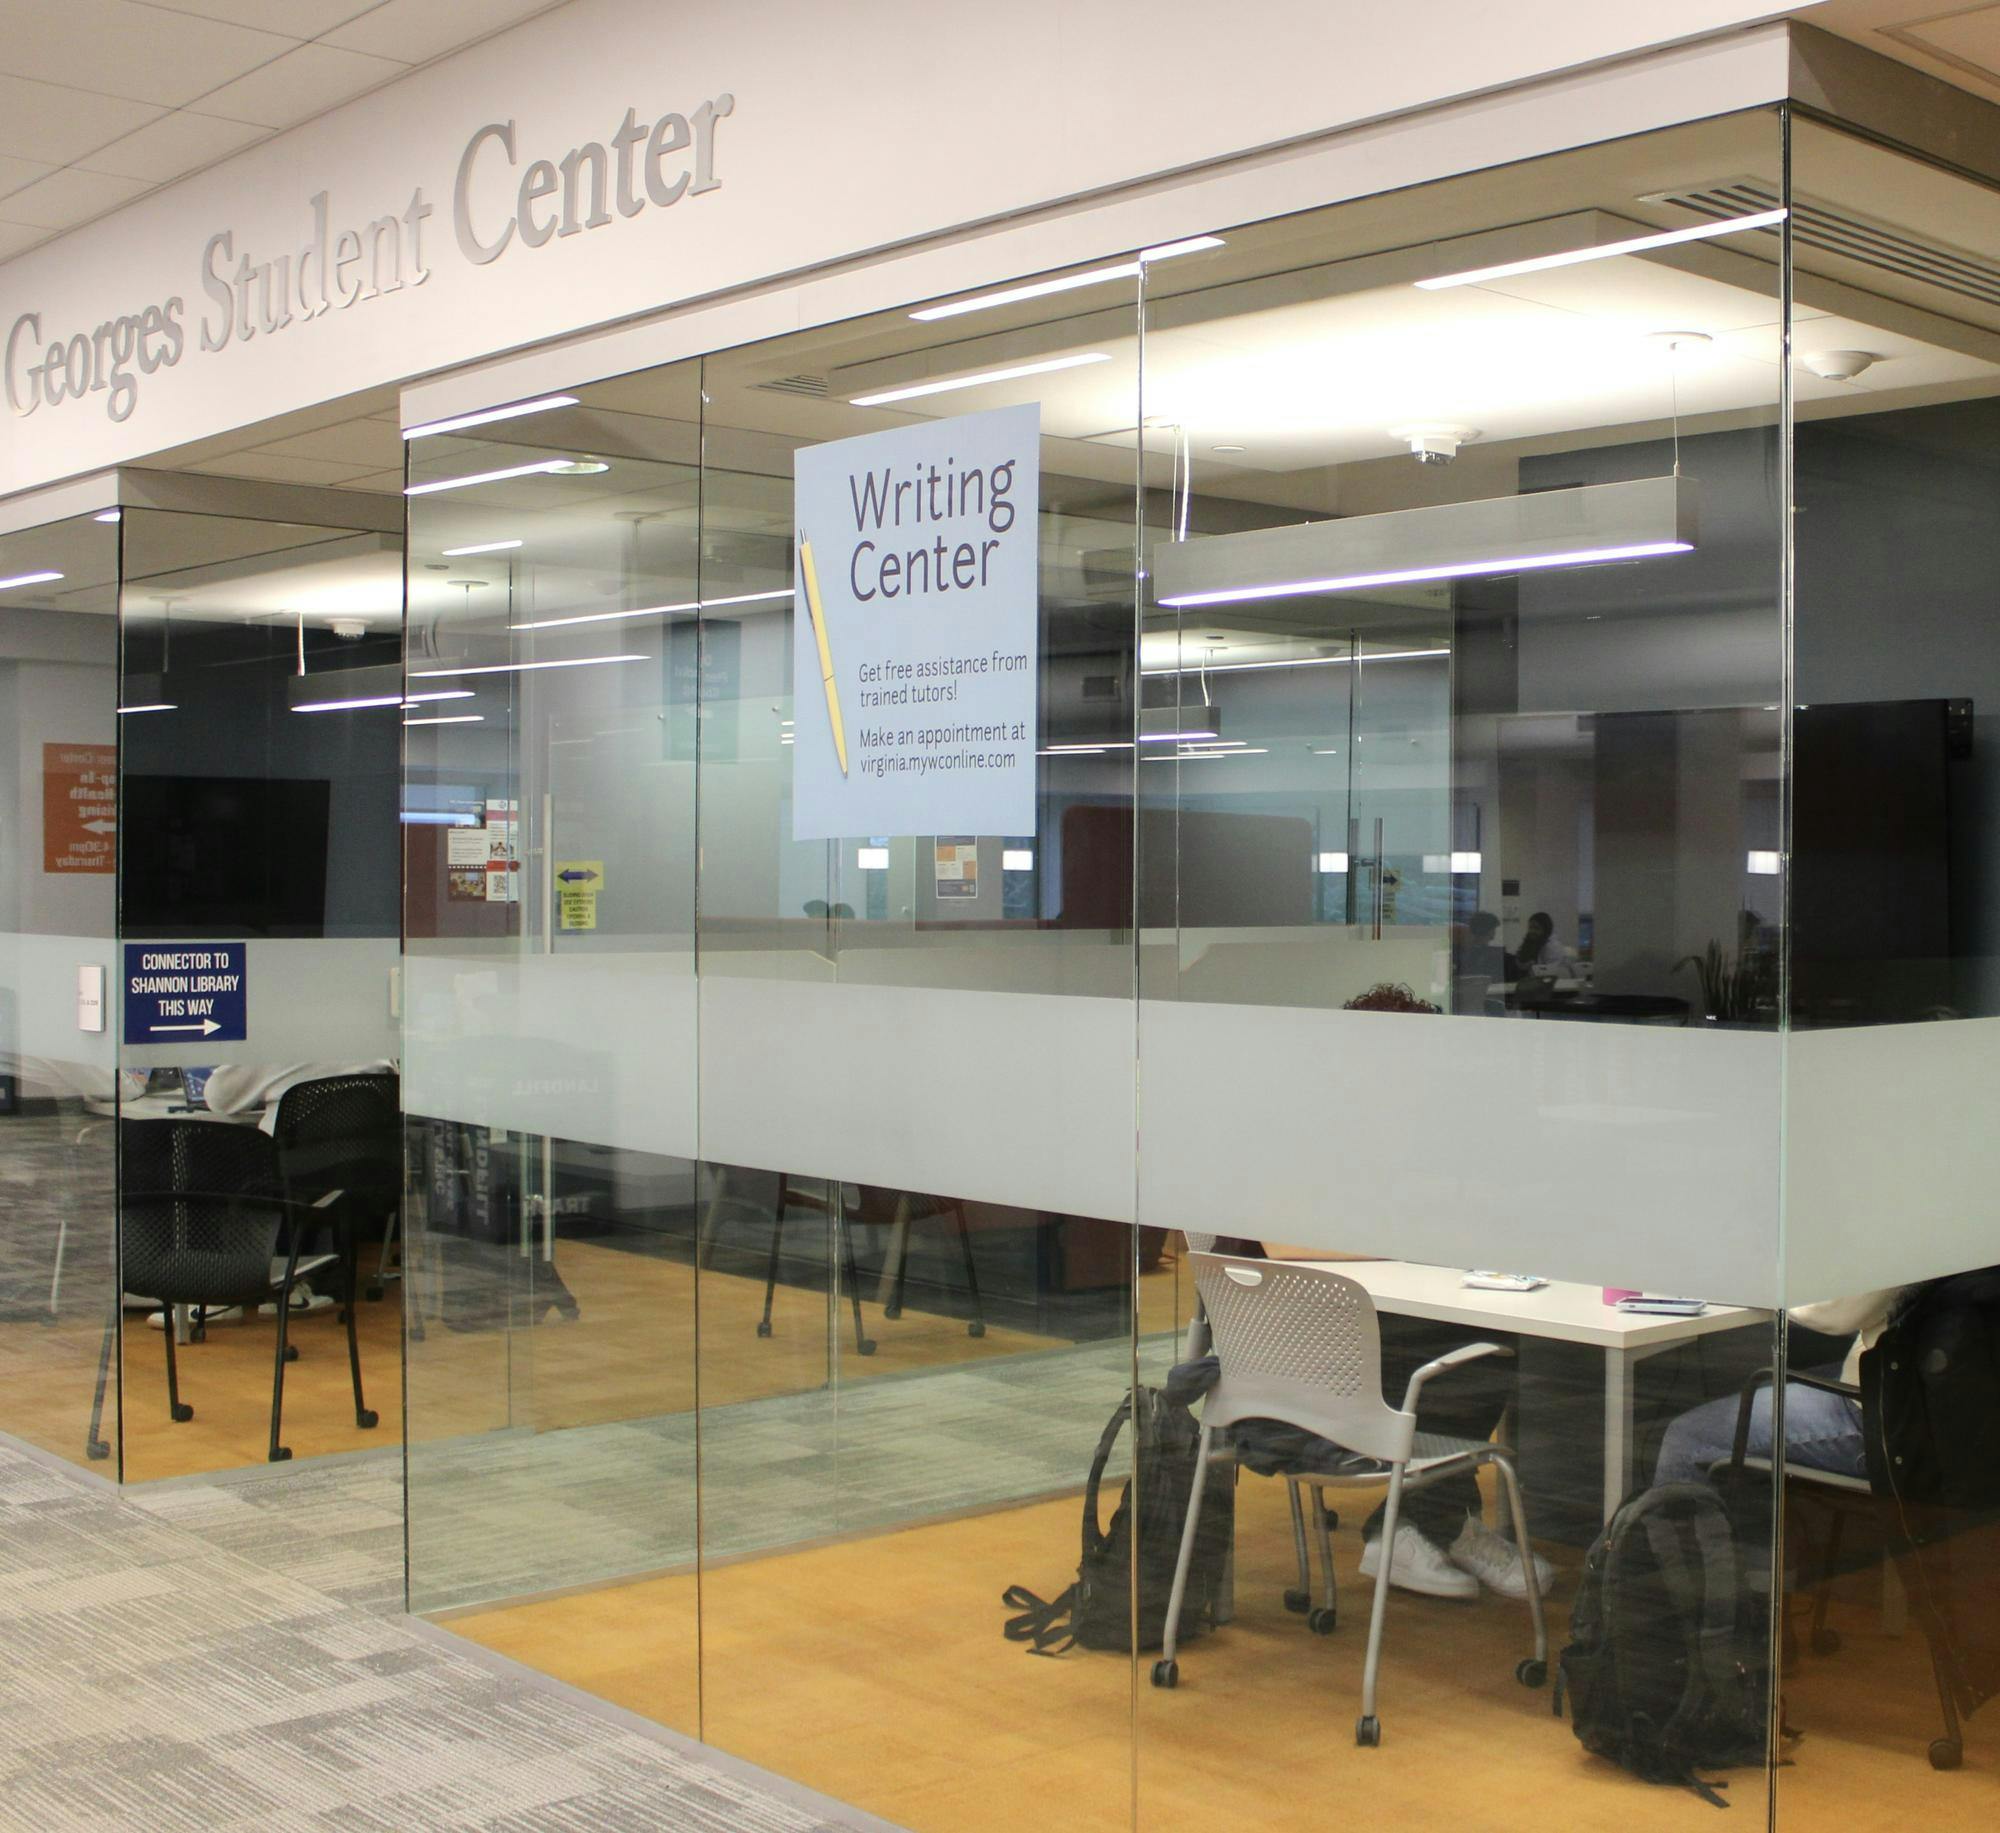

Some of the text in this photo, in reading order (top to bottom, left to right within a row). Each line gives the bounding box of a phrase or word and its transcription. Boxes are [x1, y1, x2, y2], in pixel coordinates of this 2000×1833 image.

[5, 92, 735, 423] Georges Student Center
[849, 456, 1016, 533] Writing
[850, 535, 1001, 601] Center
[859, 650, 1028, 683] Get free assistance from
[860, 679, 958, 708] trained tutors!
[859, 721, 1027, 750] Make an appointment at
[860, 748, 1017, 778] virginia.mywconline.com
[142, 952, 229, 970] CONNECTOR TO
[131, 975, 240, 994] SHANNON LIBRARY
[158, 999, 214, 1016] THIS WAY
